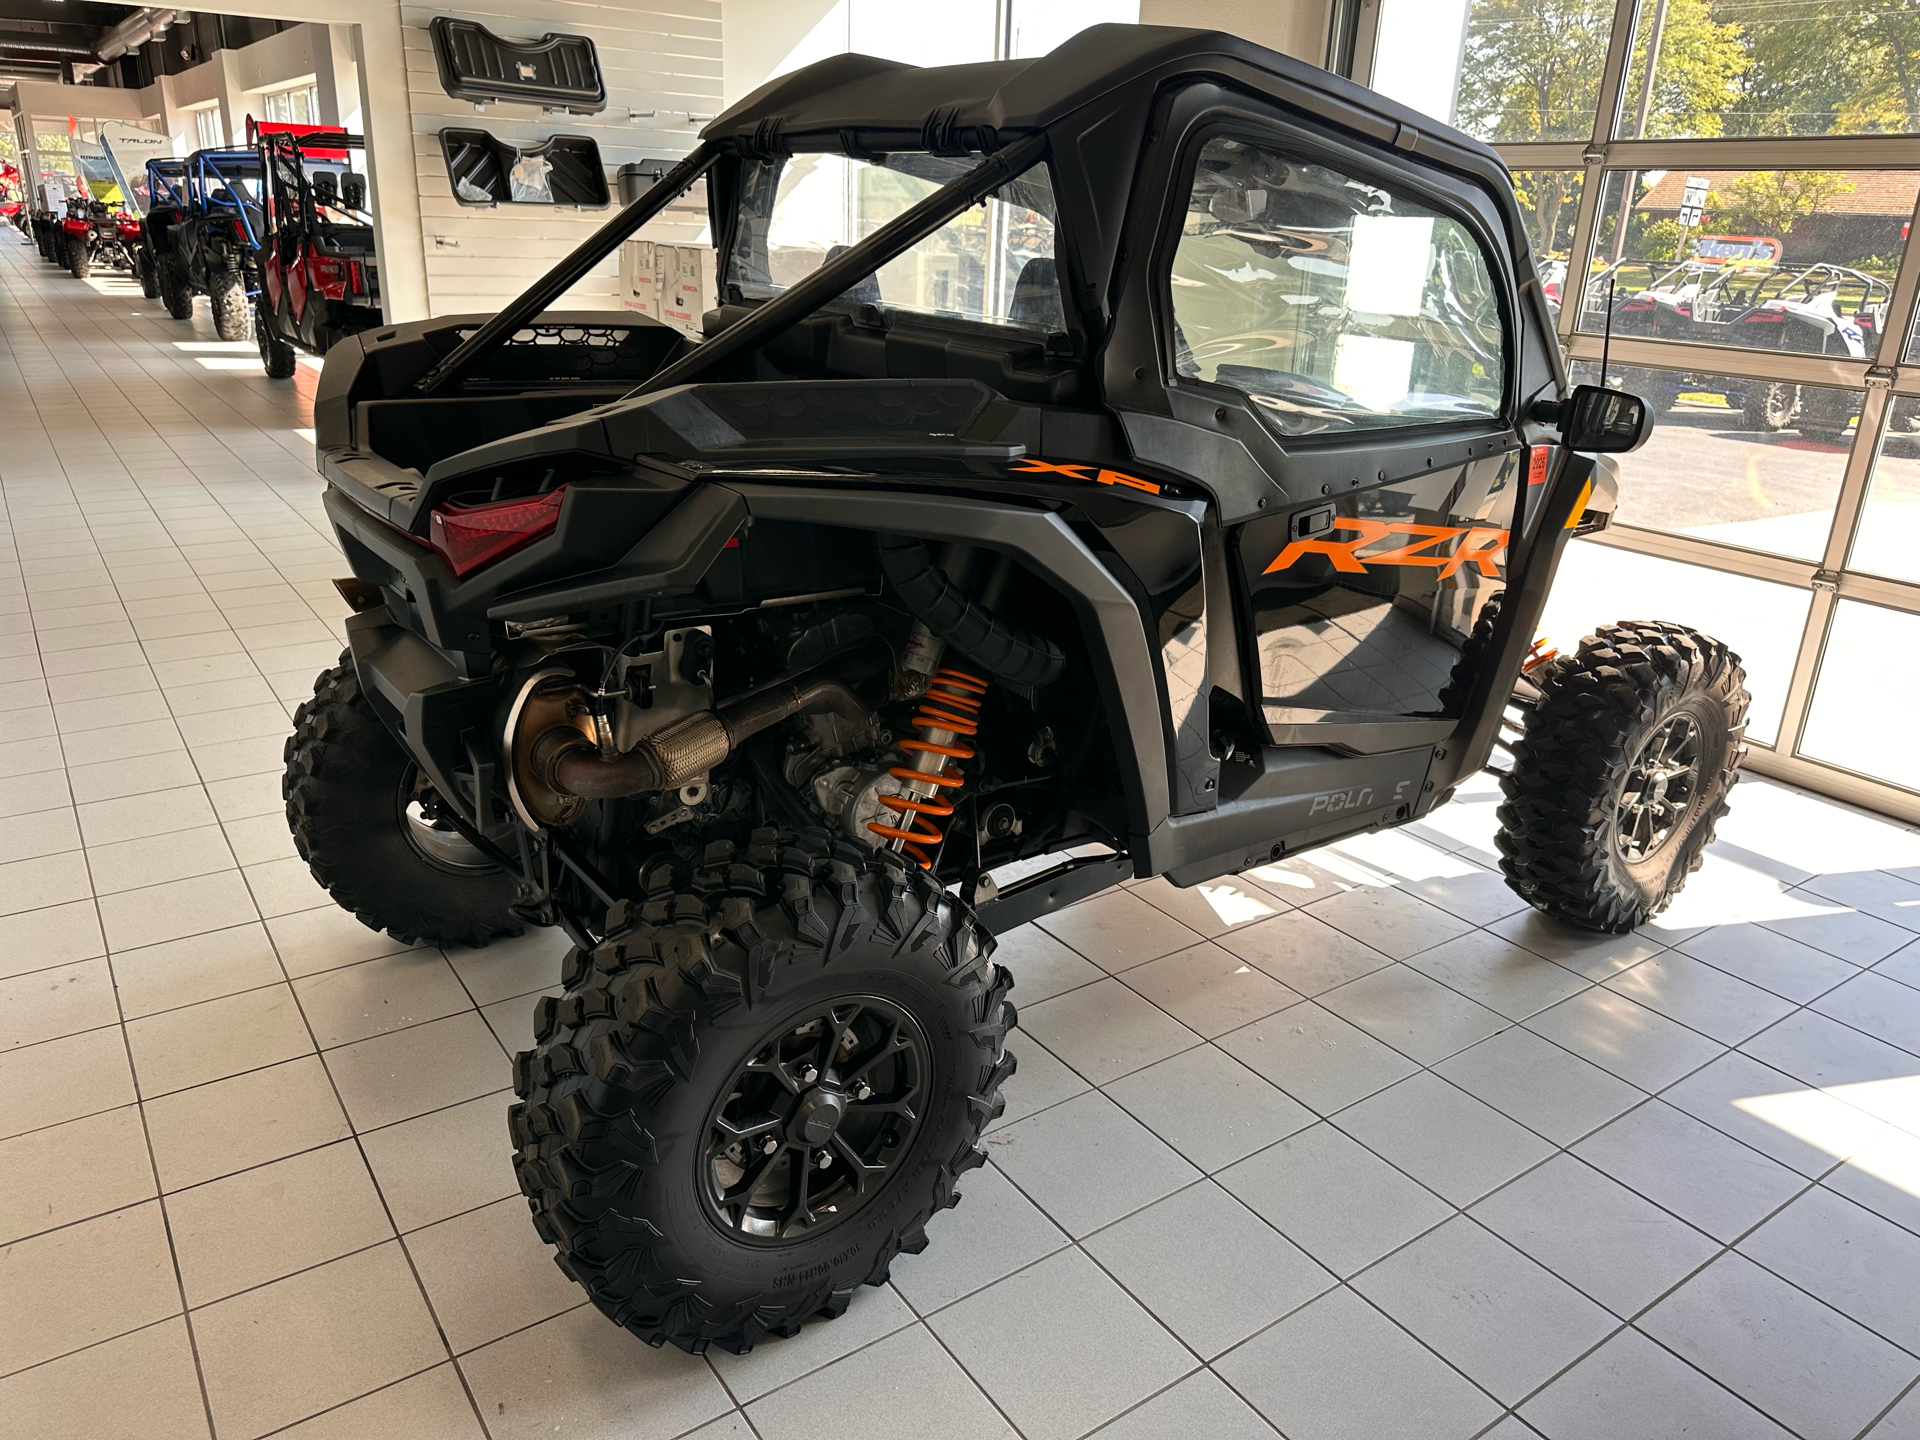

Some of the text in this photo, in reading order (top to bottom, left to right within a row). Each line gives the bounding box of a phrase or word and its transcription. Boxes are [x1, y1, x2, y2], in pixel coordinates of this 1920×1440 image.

[1007, 458, 1161, 494] XP
[1532, 457, 1546, 470] 2026
[1261, 516, 1511, 582] RZR
